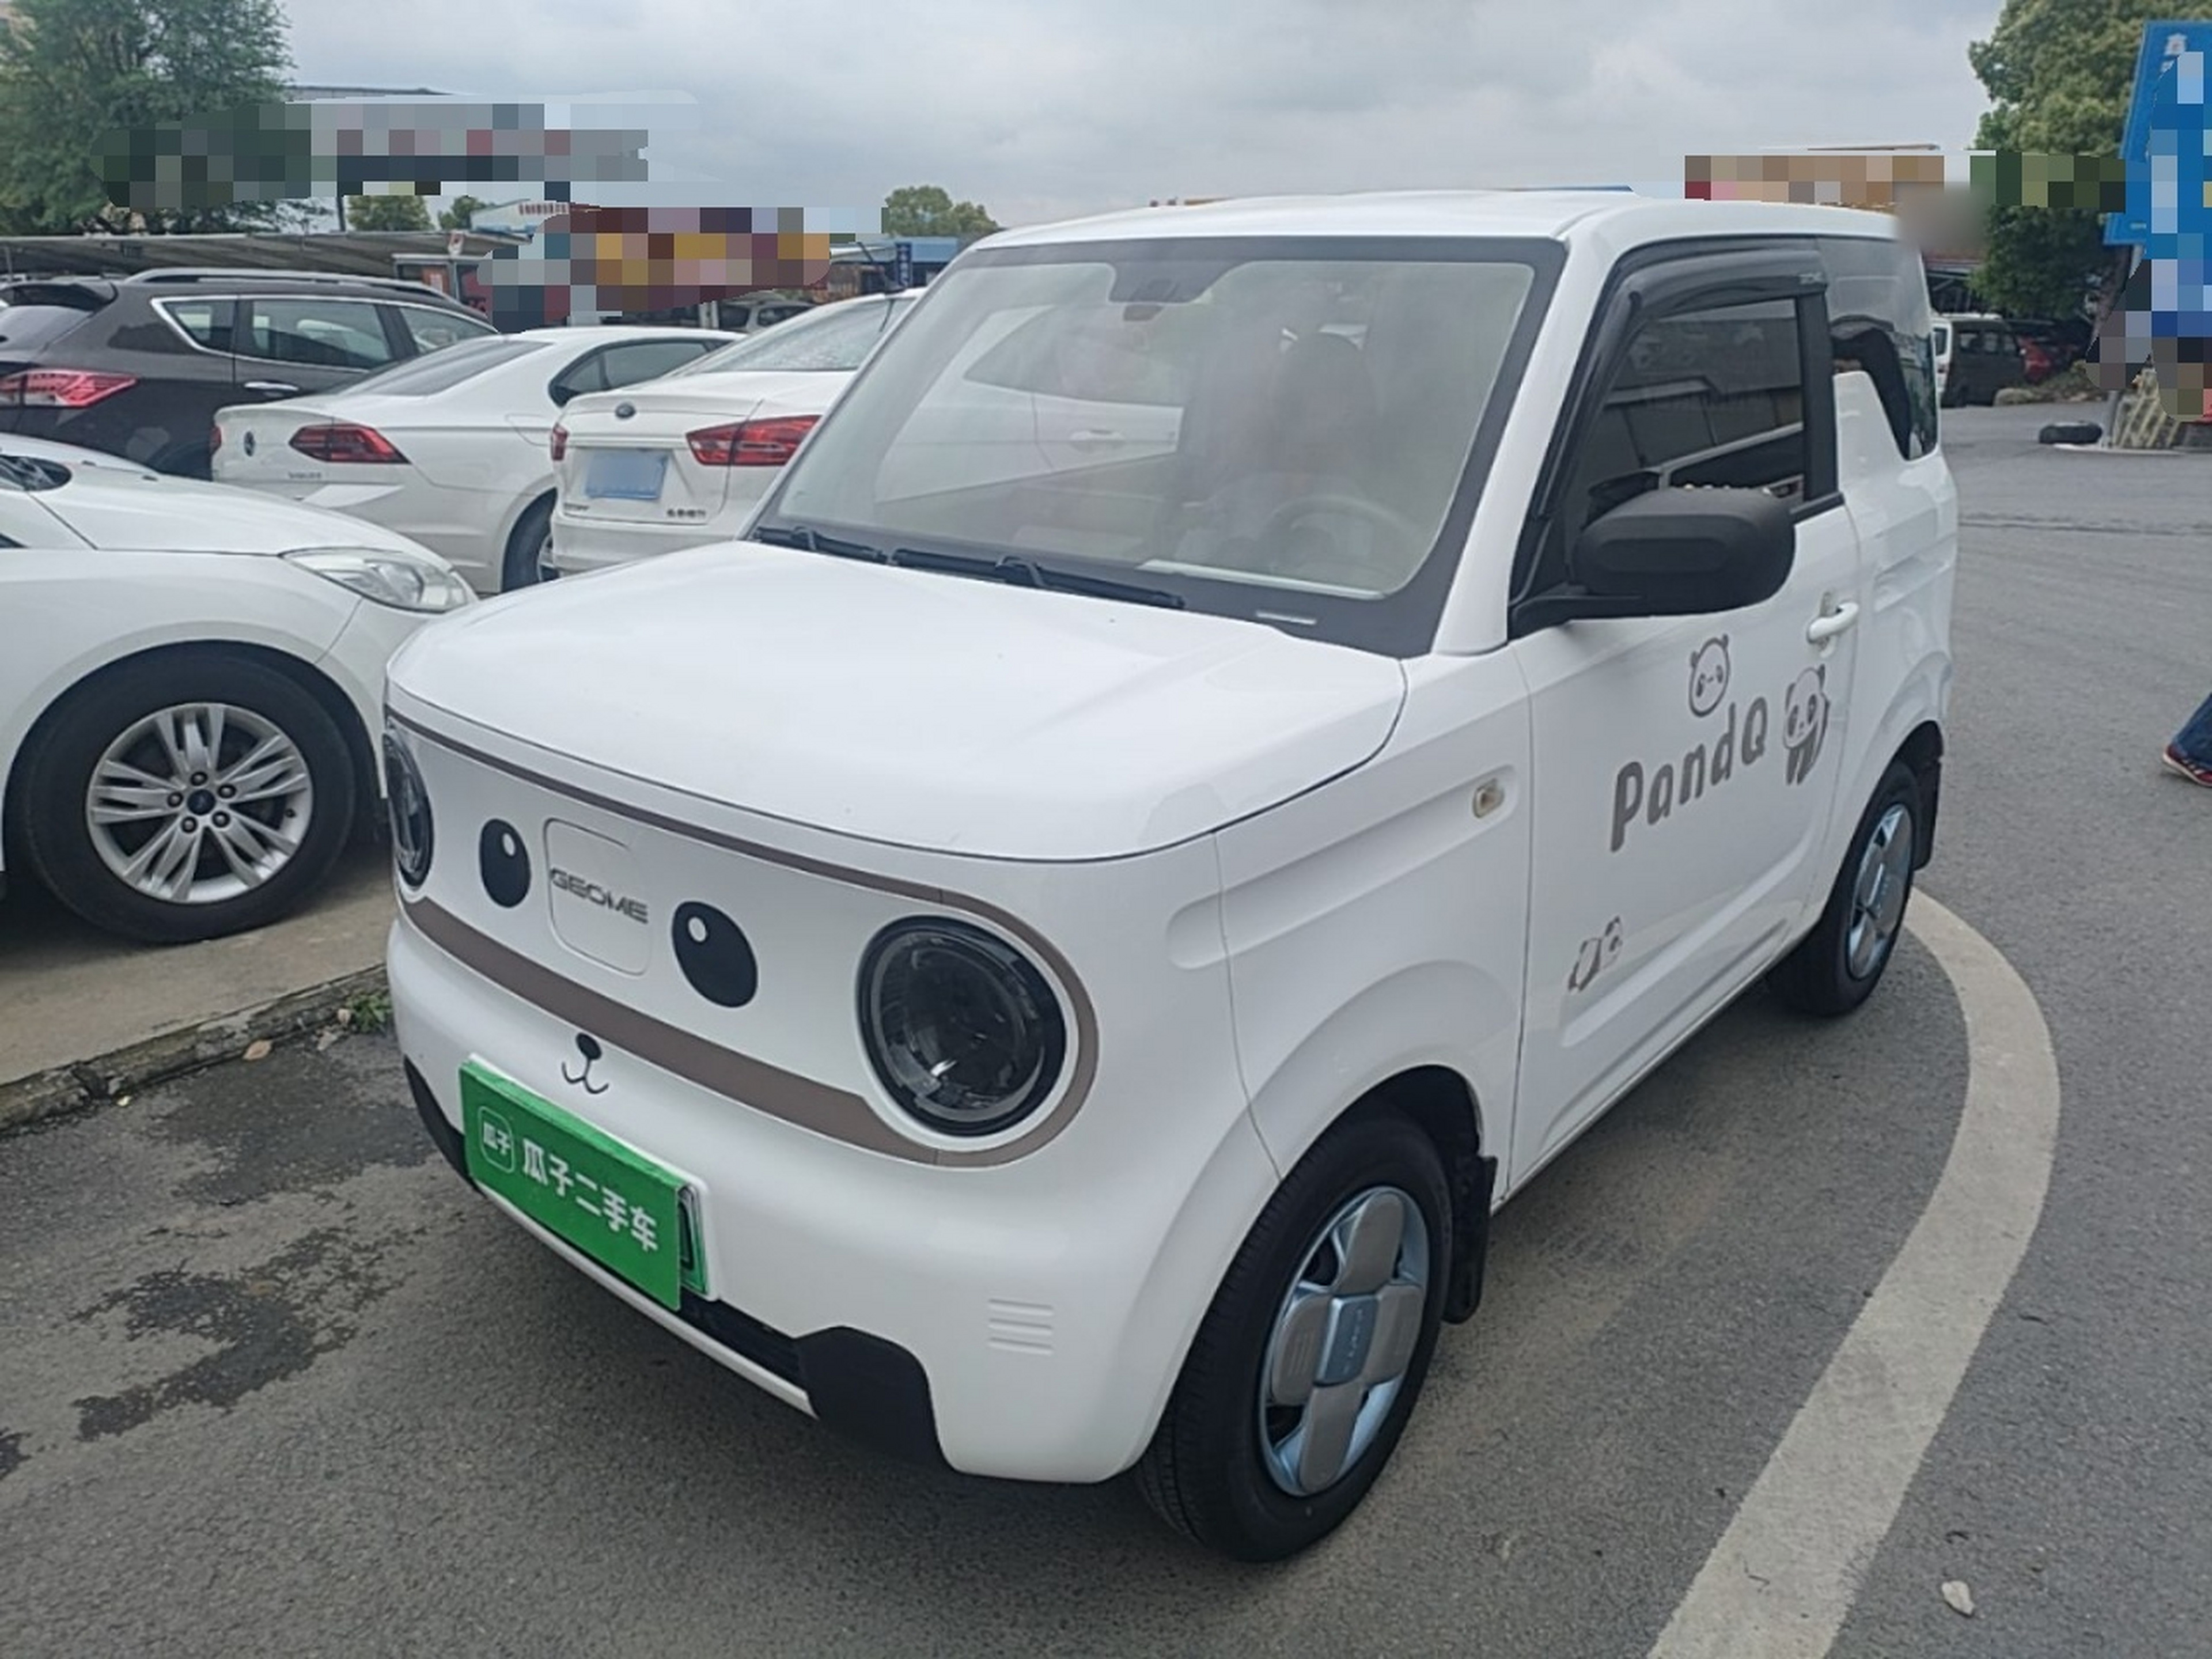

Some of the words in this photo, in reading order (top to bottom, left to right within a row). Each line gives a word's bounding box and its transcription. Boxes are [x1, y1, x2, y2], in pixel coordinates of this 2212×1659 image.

[550, 867, 649, 924] GEOME
[483, 1121, 512, 1155] 瓜子
[522, 1138, 658, 1252] 瓜子二手车
